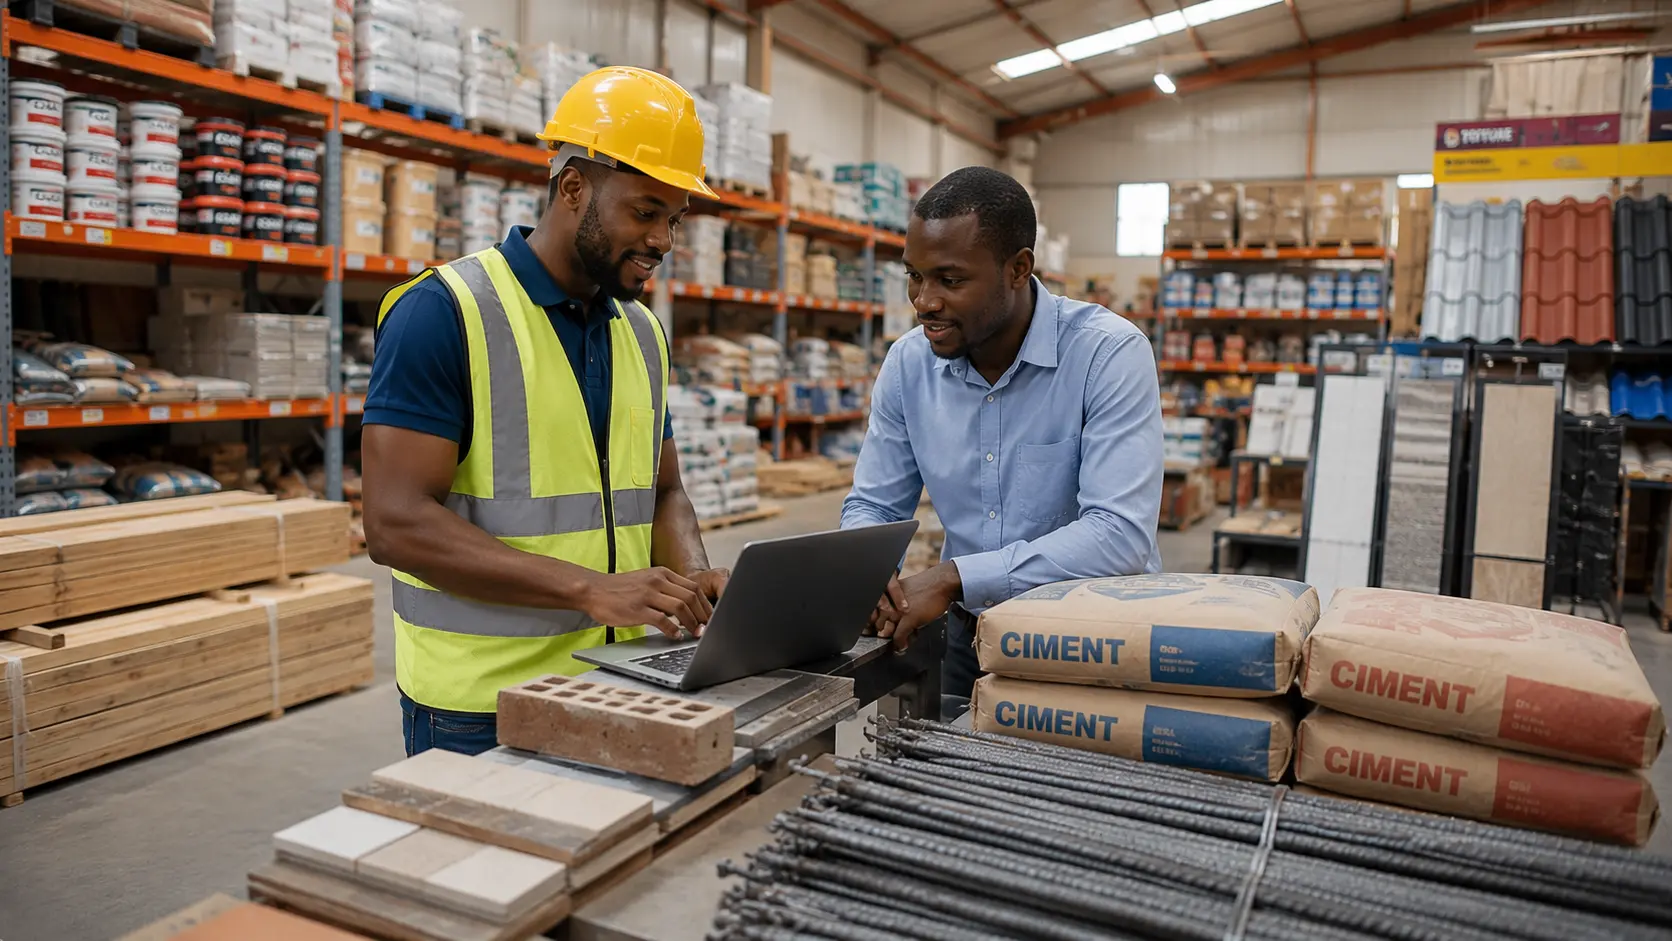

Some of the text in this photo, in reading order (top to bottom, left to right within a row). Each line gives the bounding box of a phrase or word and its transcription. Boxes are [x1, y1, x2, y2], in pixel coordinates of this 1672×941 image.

[1000, 632, 1125, 665] CIMENT
[1329, 660, 1476, 714] CIMENT
[995, 701, 1118, 741] CIMENT
[1323, 746, 1468, 797] CIMENT
